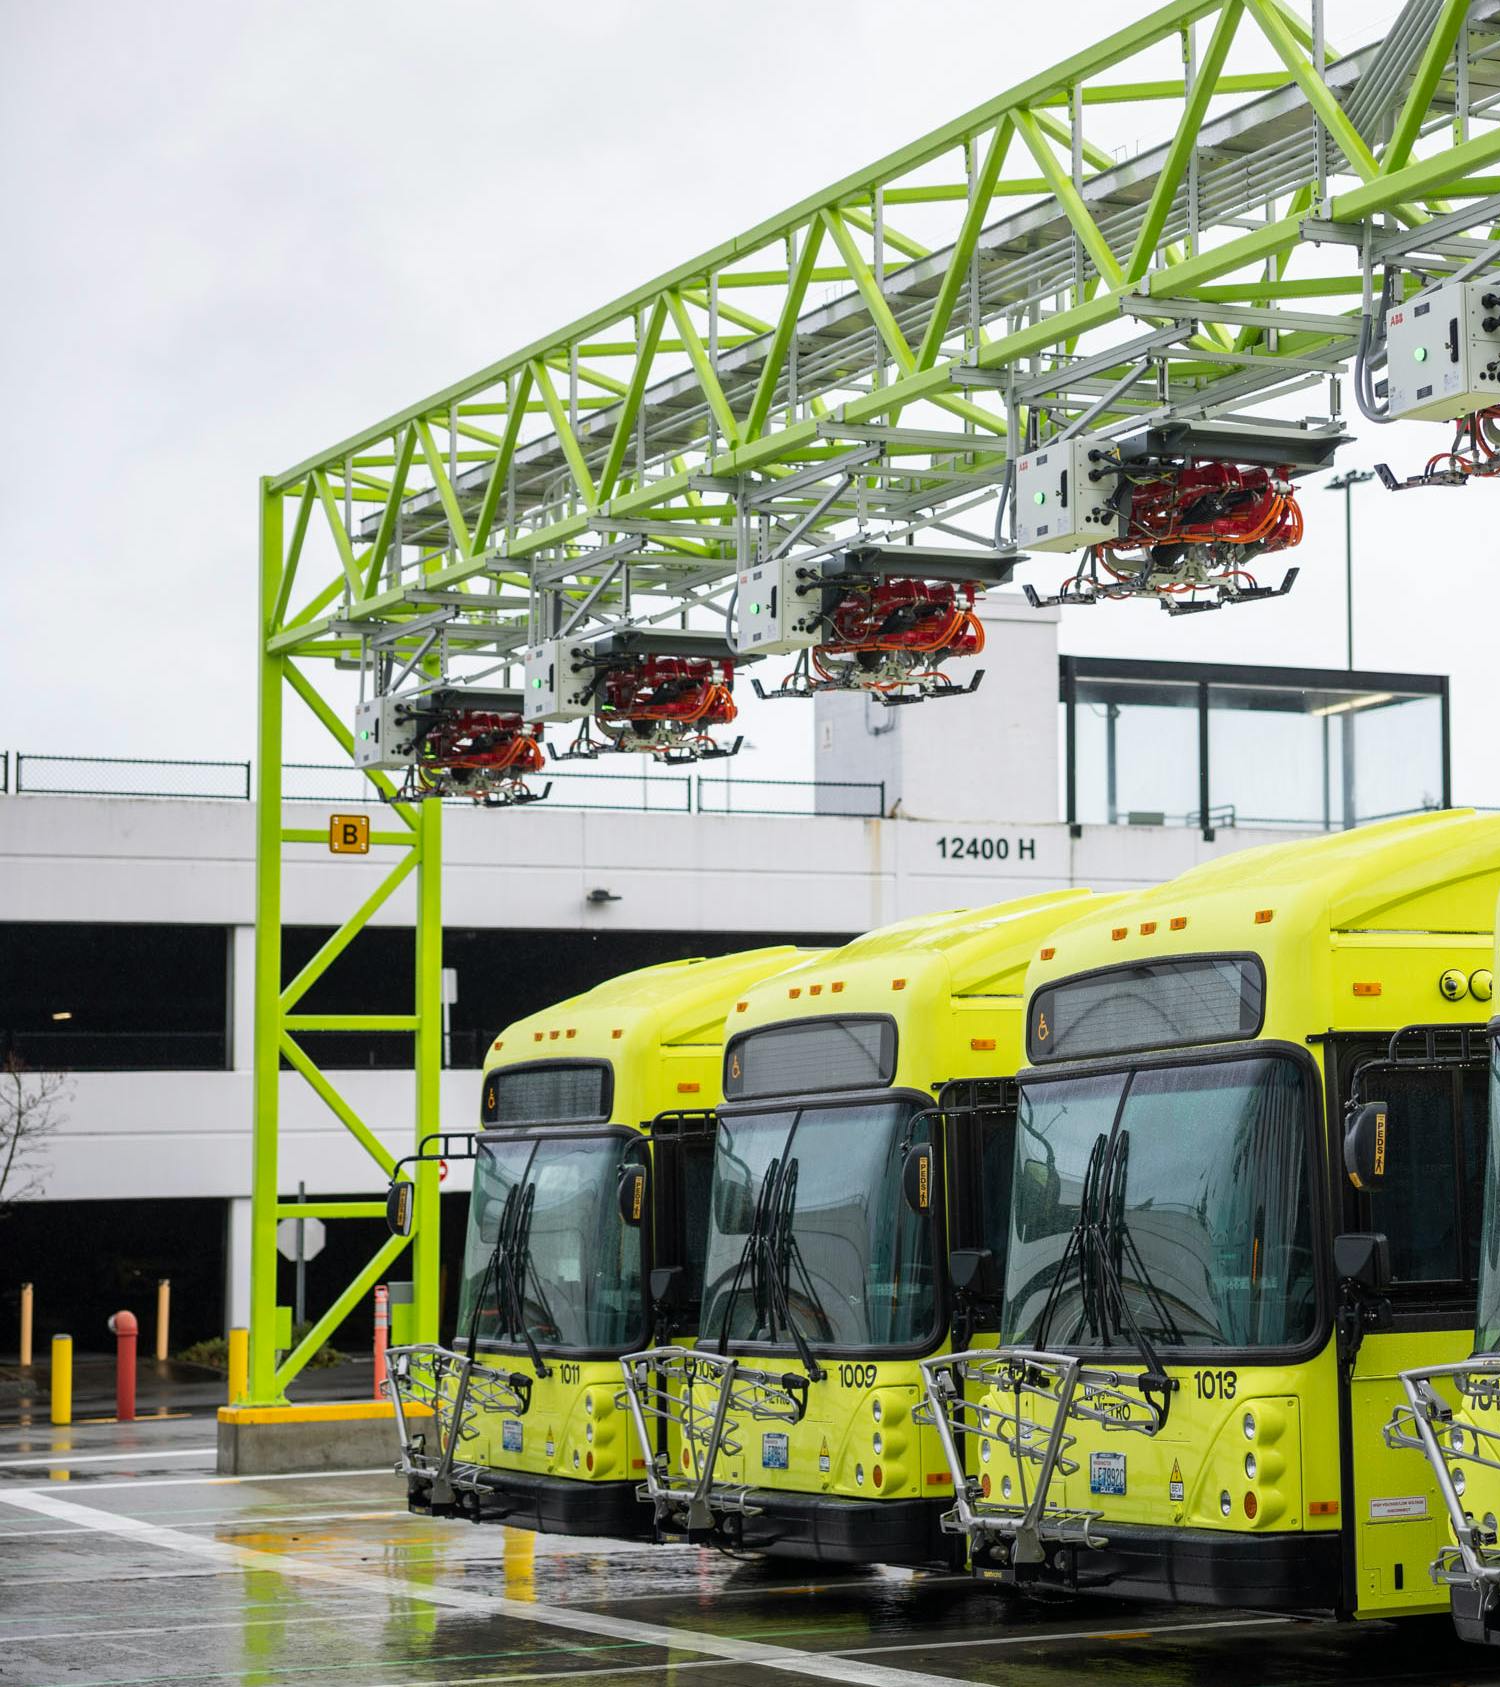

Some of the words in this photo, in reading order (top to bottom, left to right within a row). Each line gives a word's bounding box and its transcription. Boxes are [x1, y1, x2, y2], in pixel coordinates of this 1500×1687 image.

[343, 824, 358, 845] B
[936, 837, 1009, 860] 12400
[1018, 838, 1035, 860] H
[560, 1363, 580, 1385] 1011
[838, 1363, 877, 1389] 1009
[1194, 1370, 1238, 1400] 1013
